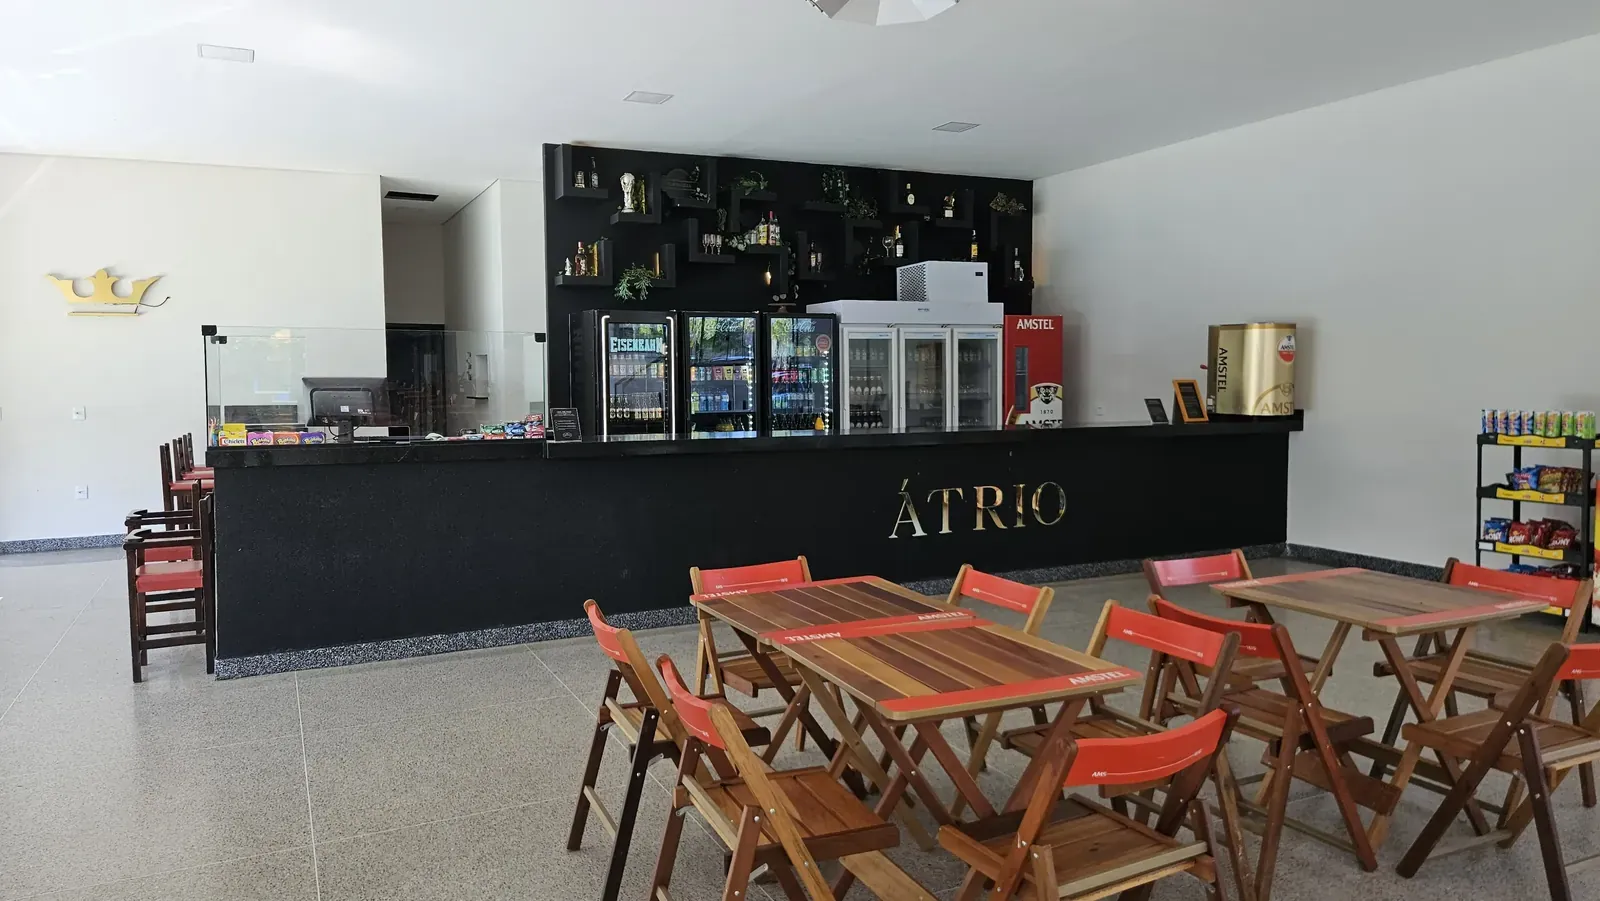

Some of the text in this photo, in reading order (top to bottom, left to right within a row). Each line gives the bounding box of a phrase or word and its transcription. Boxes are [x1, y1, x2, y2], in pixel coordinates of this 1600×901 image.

[1016, 318, 1055, 330] AMSTEL
[610, 336, 664, 353] EISENBAHN
[1217, 347, 1228, 393] AMSTEL
[888, 478, 1067, 539] ÁTRIO
[917, 611, 969, 621] AMSTEL
[784, 631, 842, 642] AMSTEL
[1068, 670, 1131, 685] AMSTEL
